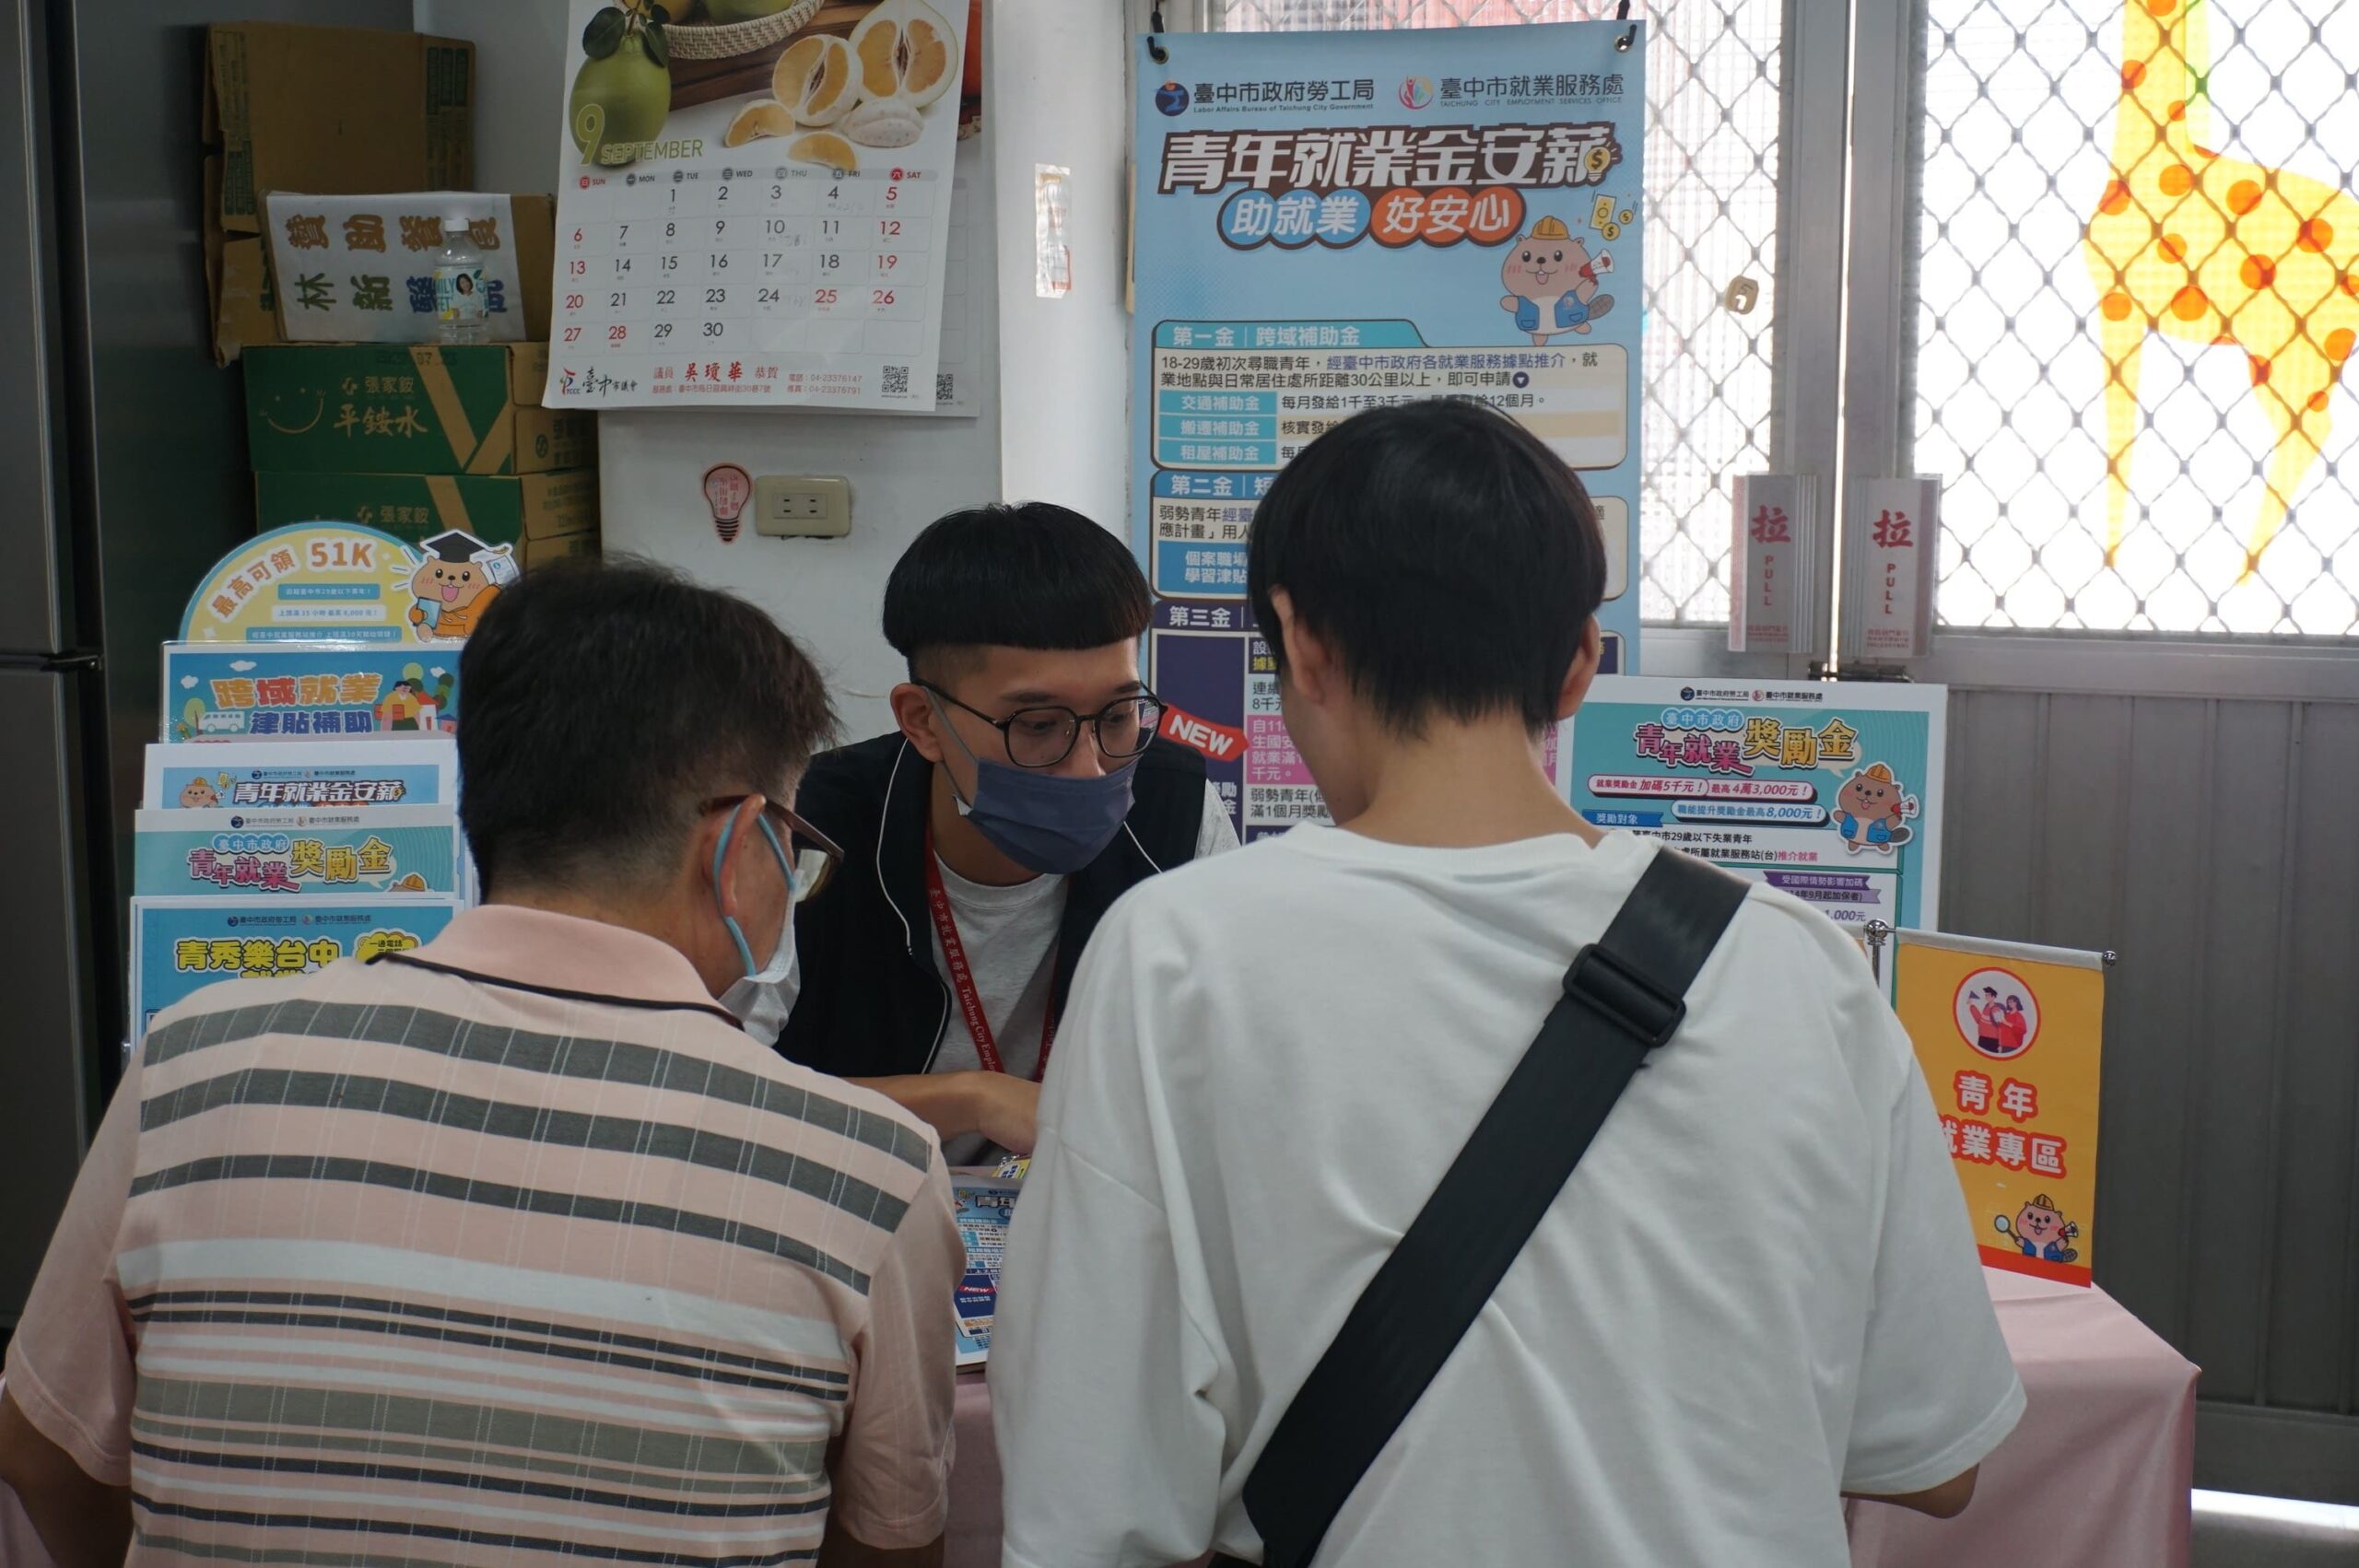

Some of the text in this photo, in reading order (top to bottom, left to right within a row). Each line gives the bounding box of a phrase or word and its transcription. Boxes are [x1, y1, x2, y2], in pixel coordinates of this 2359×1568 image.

[1193, 79, 1374, 103] 臺中市政府勞工局
[1440, 74, 1624, 99] 臺中市就業服務處
[1279, 104, 1311, 113] Taichung
[1313, 104, 1327, 112] City
[576, 103, 703, 167] 9 SEPTEMBER
[1164, 126, 1611, 191] 青年就業金安薪
[671, 189, 675, 202] 1
[718, 186, 728, 200] 2
[770, 185, 781, 200] 3
[827, 185, 839, 200] 4
[886, 186, 898, 201] 5
[1232, 193, 1509, 235] 助就業 好安心
[620, 226, 628, 240] 7
[666, 223, 675, 236] 8
[716, 221, 725, 234] 9
[766, 219, 785, 234] 10
[822, 220, 839, 235] 11
[880, 221, 900, 236] 12
[574, 228, 582, 241] 6
[569, 261, 586, 275] 13
[616, 259, 631, 272] 14
[662, 256, 678, 270] 15
[710, 254, 728, 268] 16
[763, 253, 783, 268] 17
[820, 254, 839, 269] 18
[878, 255, 898, 270] 19
[566, 295, 583, 309] 20
[610, 293, 627, 306] 21
[656, 290, 675, 305] 22
[706, 288, 726, 303] 23
[757, 288, 780, 302] 24
[815, 289, 838, 303] 25
[872, 290, 895, 305] 26
[564, 327, 581, 342] 27
[608, 325, 627, 340] 28
[654, 323, 673, 338] 29
[702, 322, 723, 336] 30
[1173, 325, 1360, 346] 第一金 跨域補助金
[653, 367, 674, 380] 議員
[1181, 395, 1260, 411] 交通補助金
[1180, 419, 1260, 436] 搬遷補助金
[1180, 445, 1260, 462] 租屋補助金
[1171, 474, 1233, 496] 第二金
[1751, 505, 1790, 544] 拉
[1872, 509, 1913, 548] 拉
[311, 542, 372, 568] 51K
[212, 549, 295, 617] 最高可領
[1185, 568, 1248, 584] 學習津貼
[1764, 555, 1775, 606] PULL
[1884, 563, 1896, 614] PULL
[1169, 606, 1231, 628] 第三金
[212, 674, 381, 708] 跨域就業
[251, 712, 372, 734] 津貼補助
[1665, 713, 1740, 727] 臺中市政府
[1169, 714, 1233, 756] NEW
[1635, 719, 1856, 774] 青年就業獎勵金
[1252, 767, 1291, 781] 千元。
[235, 781, 404, 802] 青年就業金安薪
[1597, 813, 1637, 825] 獎勵對象
[218, 839, 288, 851] 臺中市政府
[190, 837, 391, 890] 青年就業獎勵金
[1782, 875, 1863, 887] 受國際情勢影響加碼
[177, 940, 339, 970] 青秀樂台中
[962, 986, 979, 1026] Taichung
[1958, 1075, 2035, 1117] 青年
